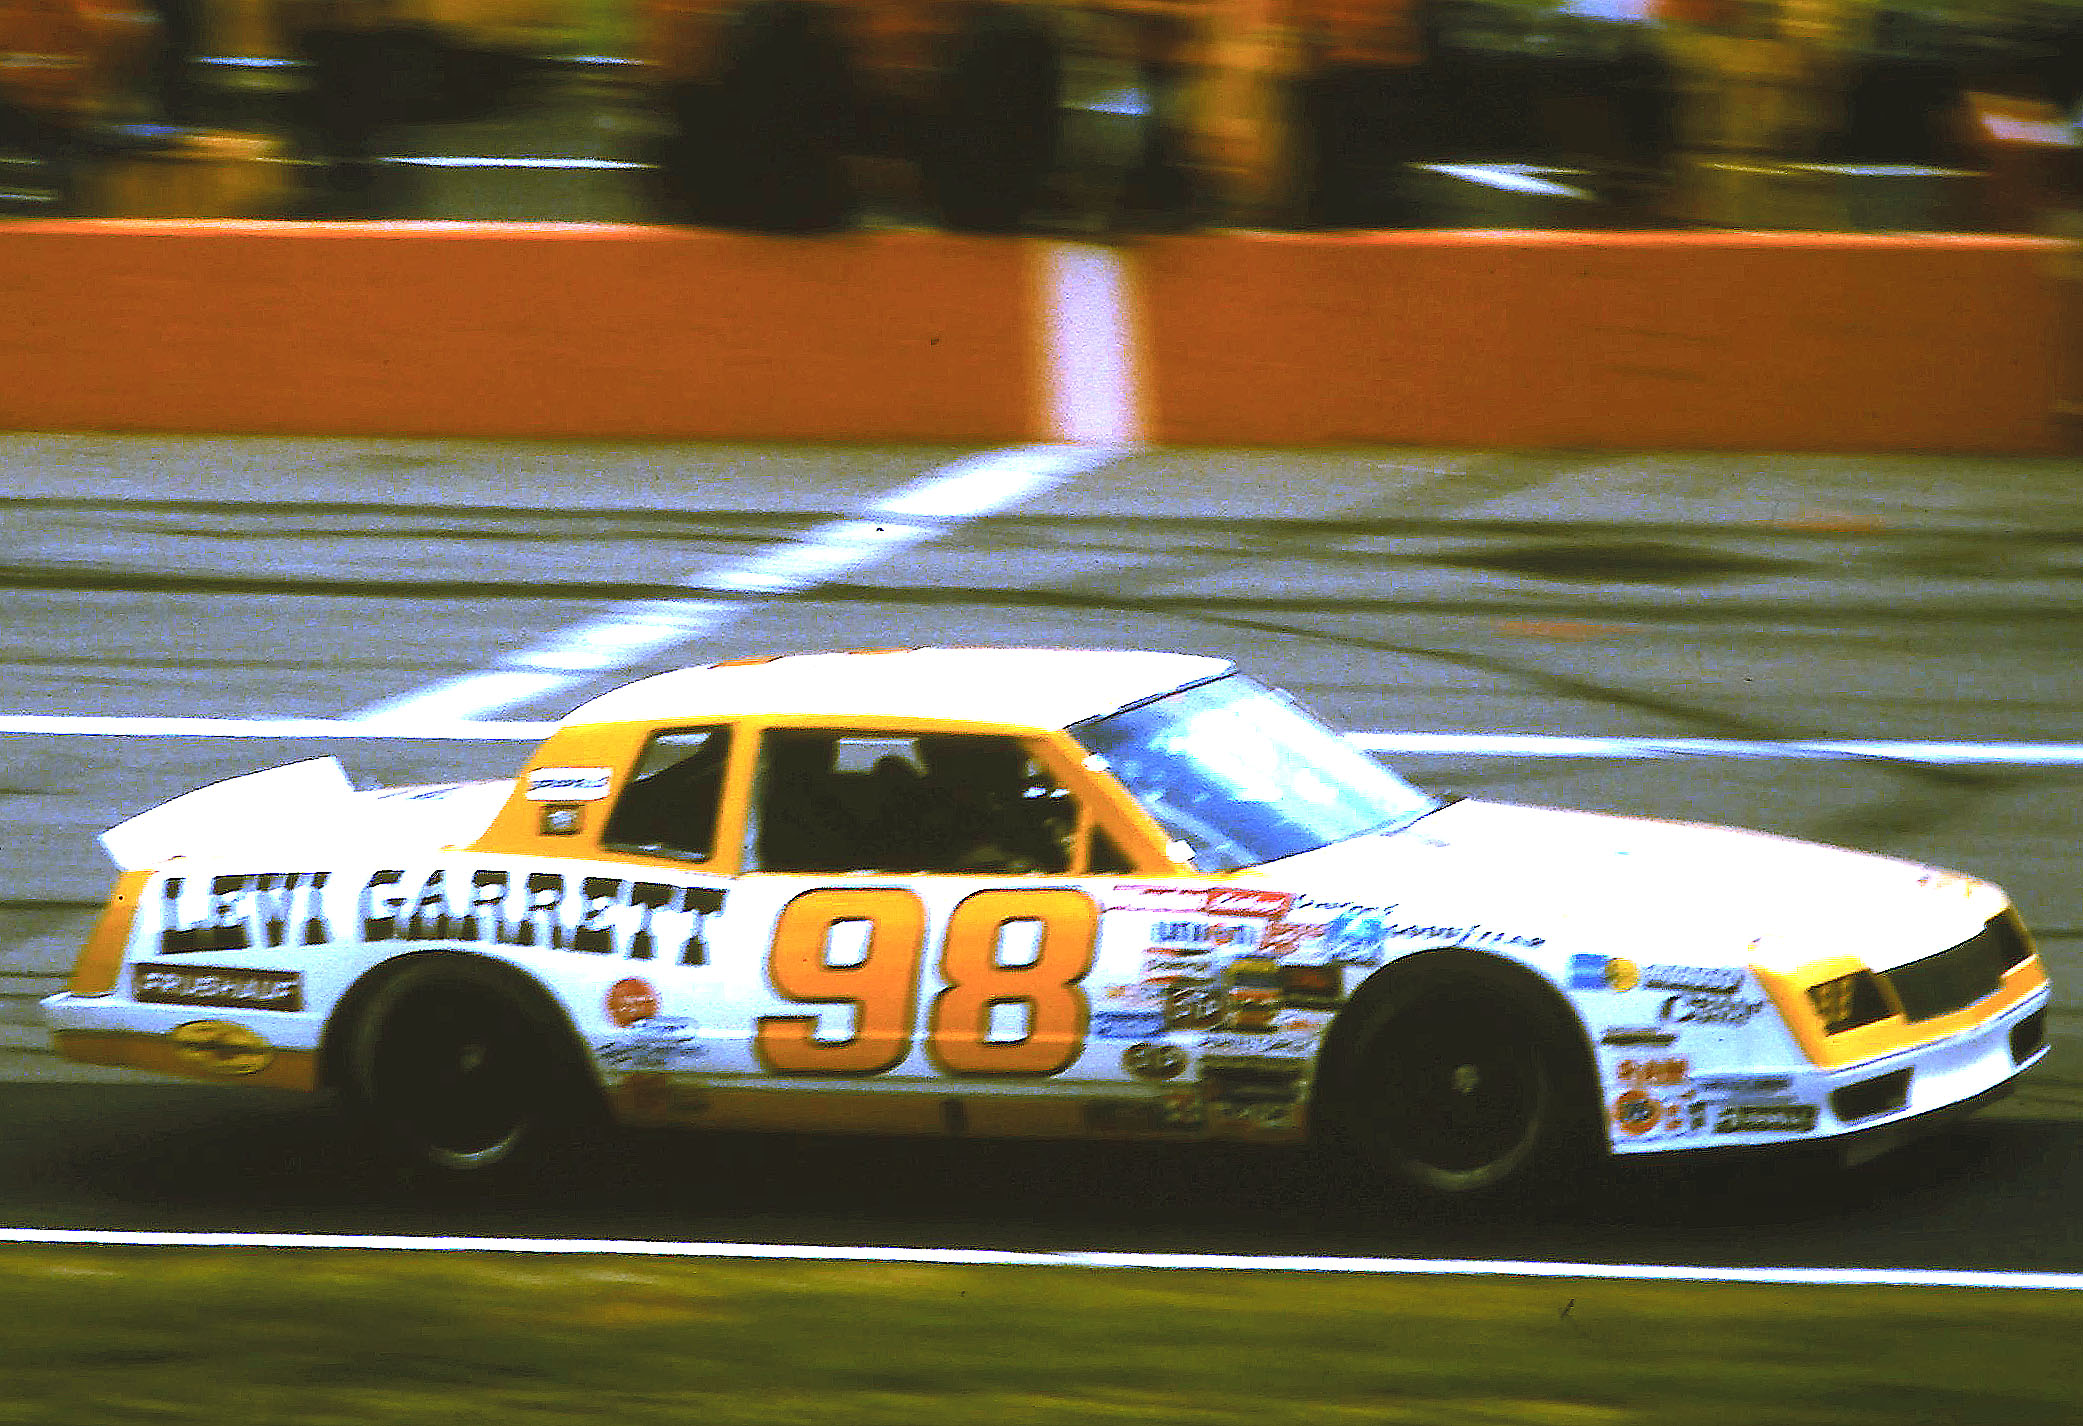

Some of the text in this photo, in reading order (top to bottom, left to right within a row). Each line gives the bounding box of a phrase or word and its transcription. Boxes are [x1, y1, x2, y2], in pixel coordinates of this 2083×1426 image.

[158, 869, 729, 966] LEVI GARRETT
[753, 886, 1104, 1080] 98
